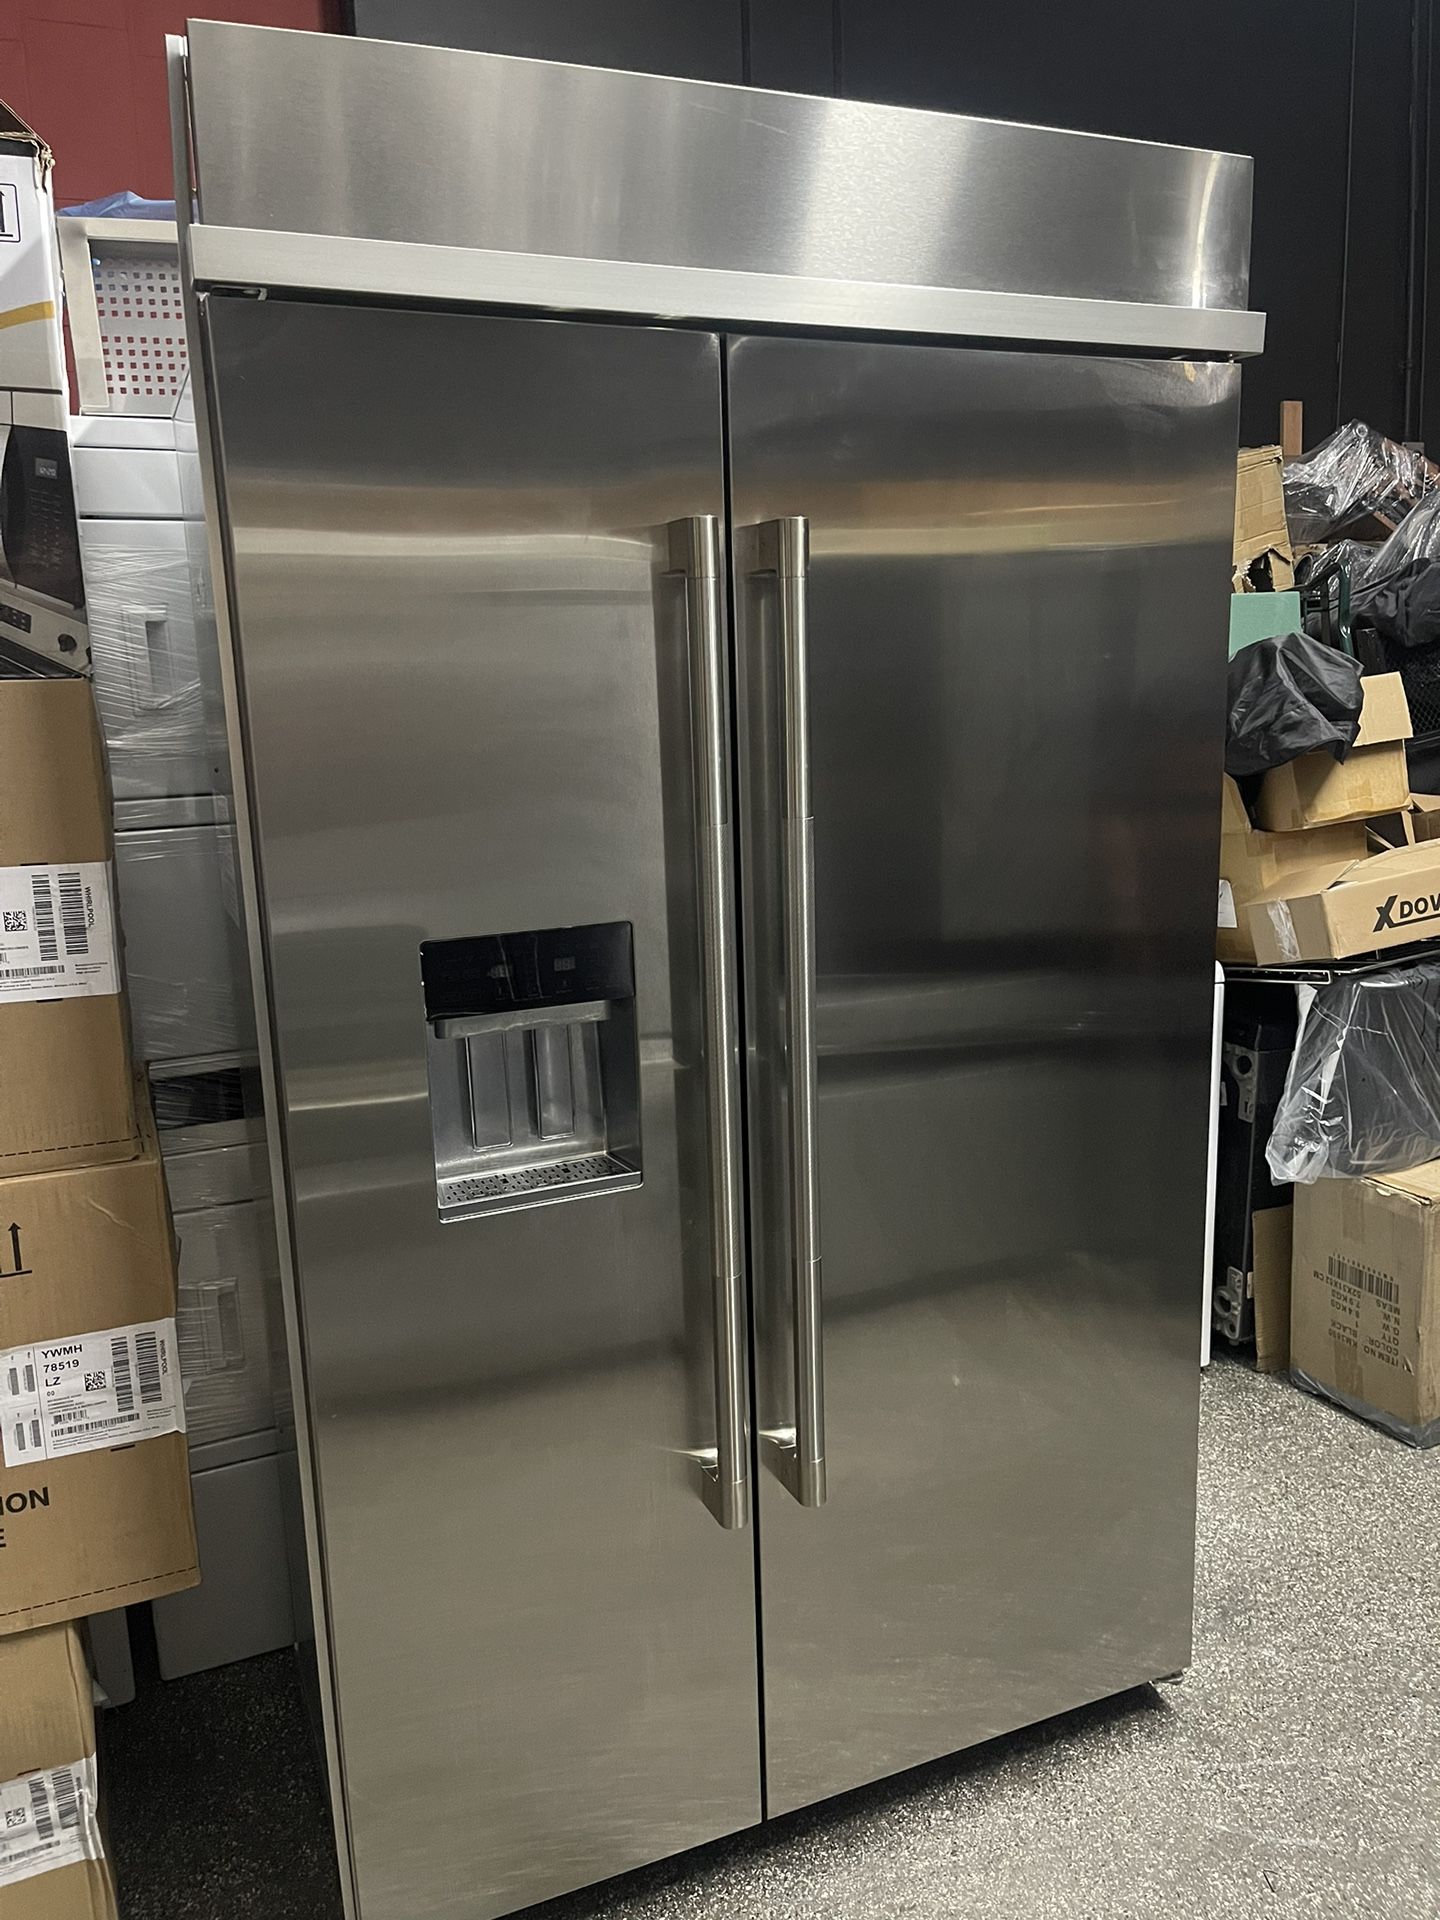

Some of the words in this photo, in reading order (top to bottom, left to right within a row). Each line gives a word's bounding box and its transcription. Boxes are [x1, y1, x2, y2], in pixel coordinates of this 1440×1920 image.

[84, 886, 95, 928] WHIRLPOOL
[41, 1344, 83, 1359] YWMH
[1377, 1350, 1399, 1367] ITEM
[43, 1359, 80, 1374] 78519
[45, 1376, 61, 1387] LZ
